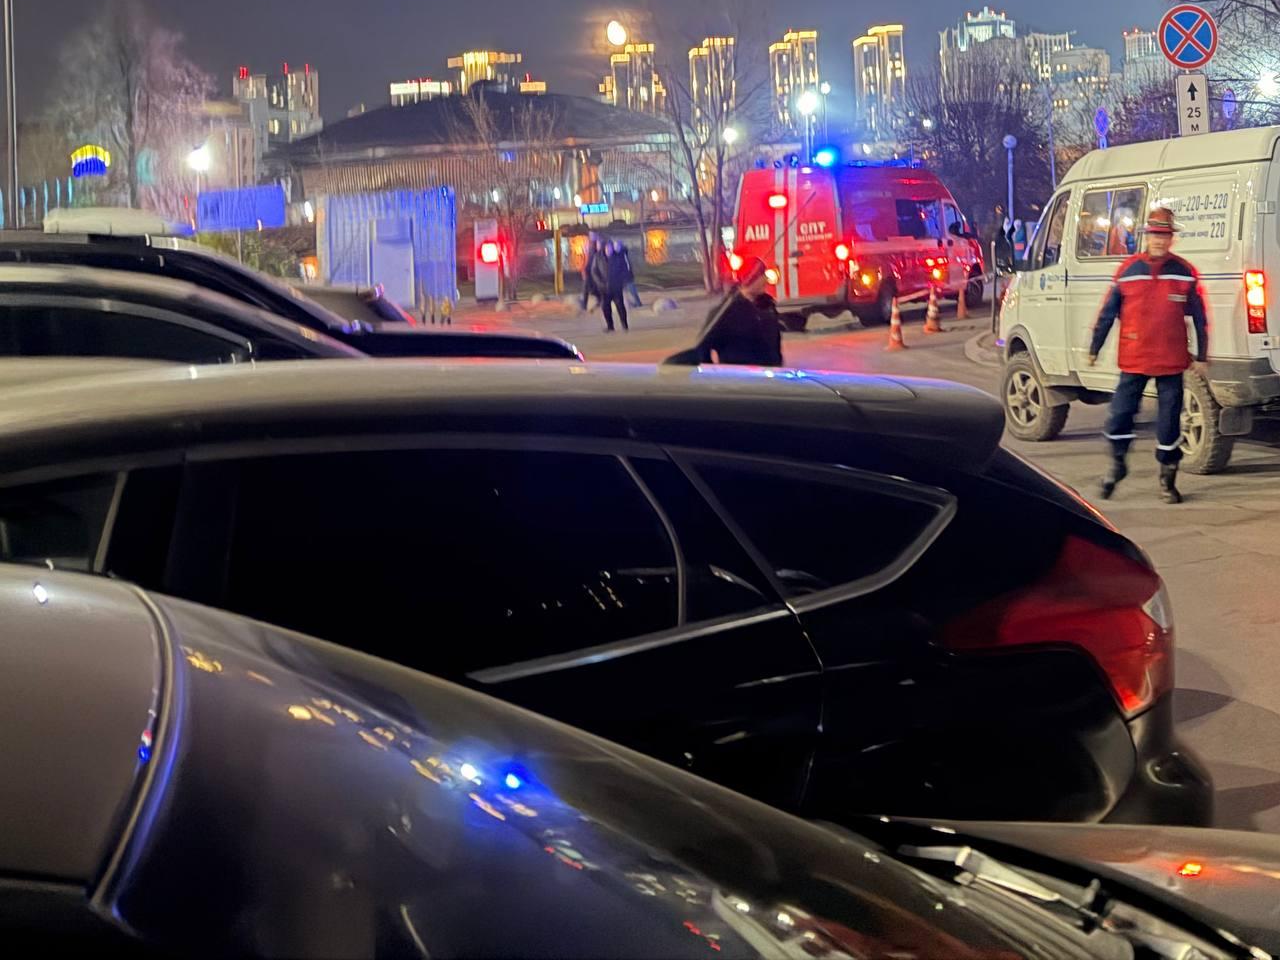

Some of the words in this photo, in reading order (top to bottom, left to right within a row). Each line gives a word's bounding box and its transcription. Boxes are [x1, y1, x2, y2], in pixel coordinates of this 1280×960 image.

[1187, 106, 1201, 119] 25
[1191, 123, 1200, 132] М
[745, 223, 770, 241] АШ
[1210, 221, 1225, 238] 220
